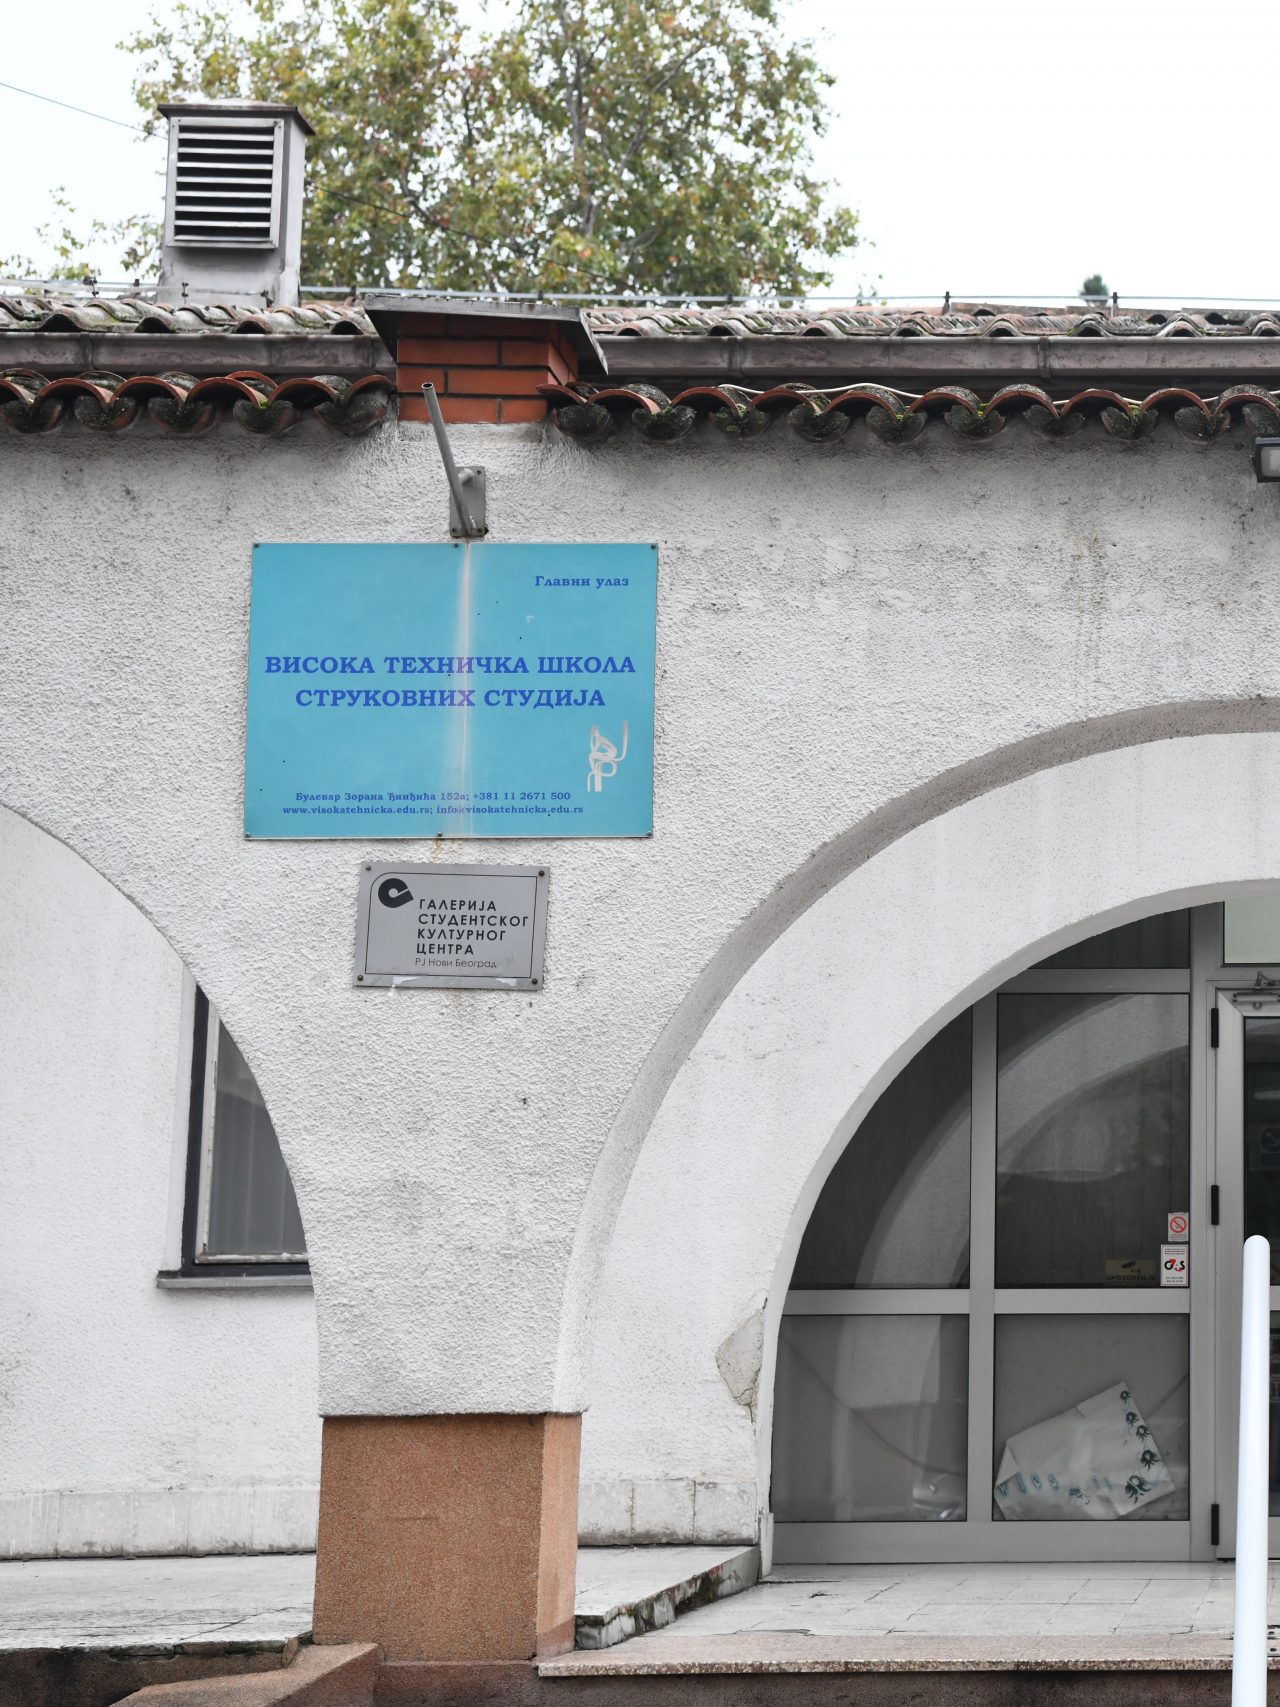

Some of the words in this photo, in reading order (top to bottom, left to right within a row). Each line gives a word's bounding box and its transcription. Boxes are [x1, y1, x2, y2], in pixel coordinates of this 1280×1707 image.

[535, 575, 591, 587] Главни
[595, 578, 629, 590] улаз
[265, 656, 375, 674] ВИСОКА
[384, 656, 529, 674] ТЕХНИЧКА
[538, 656, 636, 674] ШКОЛА
[295, 688, 475, 707] СТРУКОВНИХ
[484, 688, 605, 709] СТУДИЈА
[295, 792, 341, 803] Булевар
[344, 792, 383, 803] Зорана
[473, 792, 498, 801] +381
[504, 792, 515, 801] 11
[520, 792, 546, 801] 2671
[550, 792, 571, 801] 500
[419, 899, 497, 912] ГАЛЕРИЈА
[418, 913, 529, 927] СТУДЕНТСКОГ
[417, 928, 506, 941] КУЛТУРНОГ
[416, 943, 474, 955] ЦЕНТРА
[415, 957, 426, 967] РЈ
[428, 958, 453, 967] Нови
[455, 958, 497, 969] Београд
